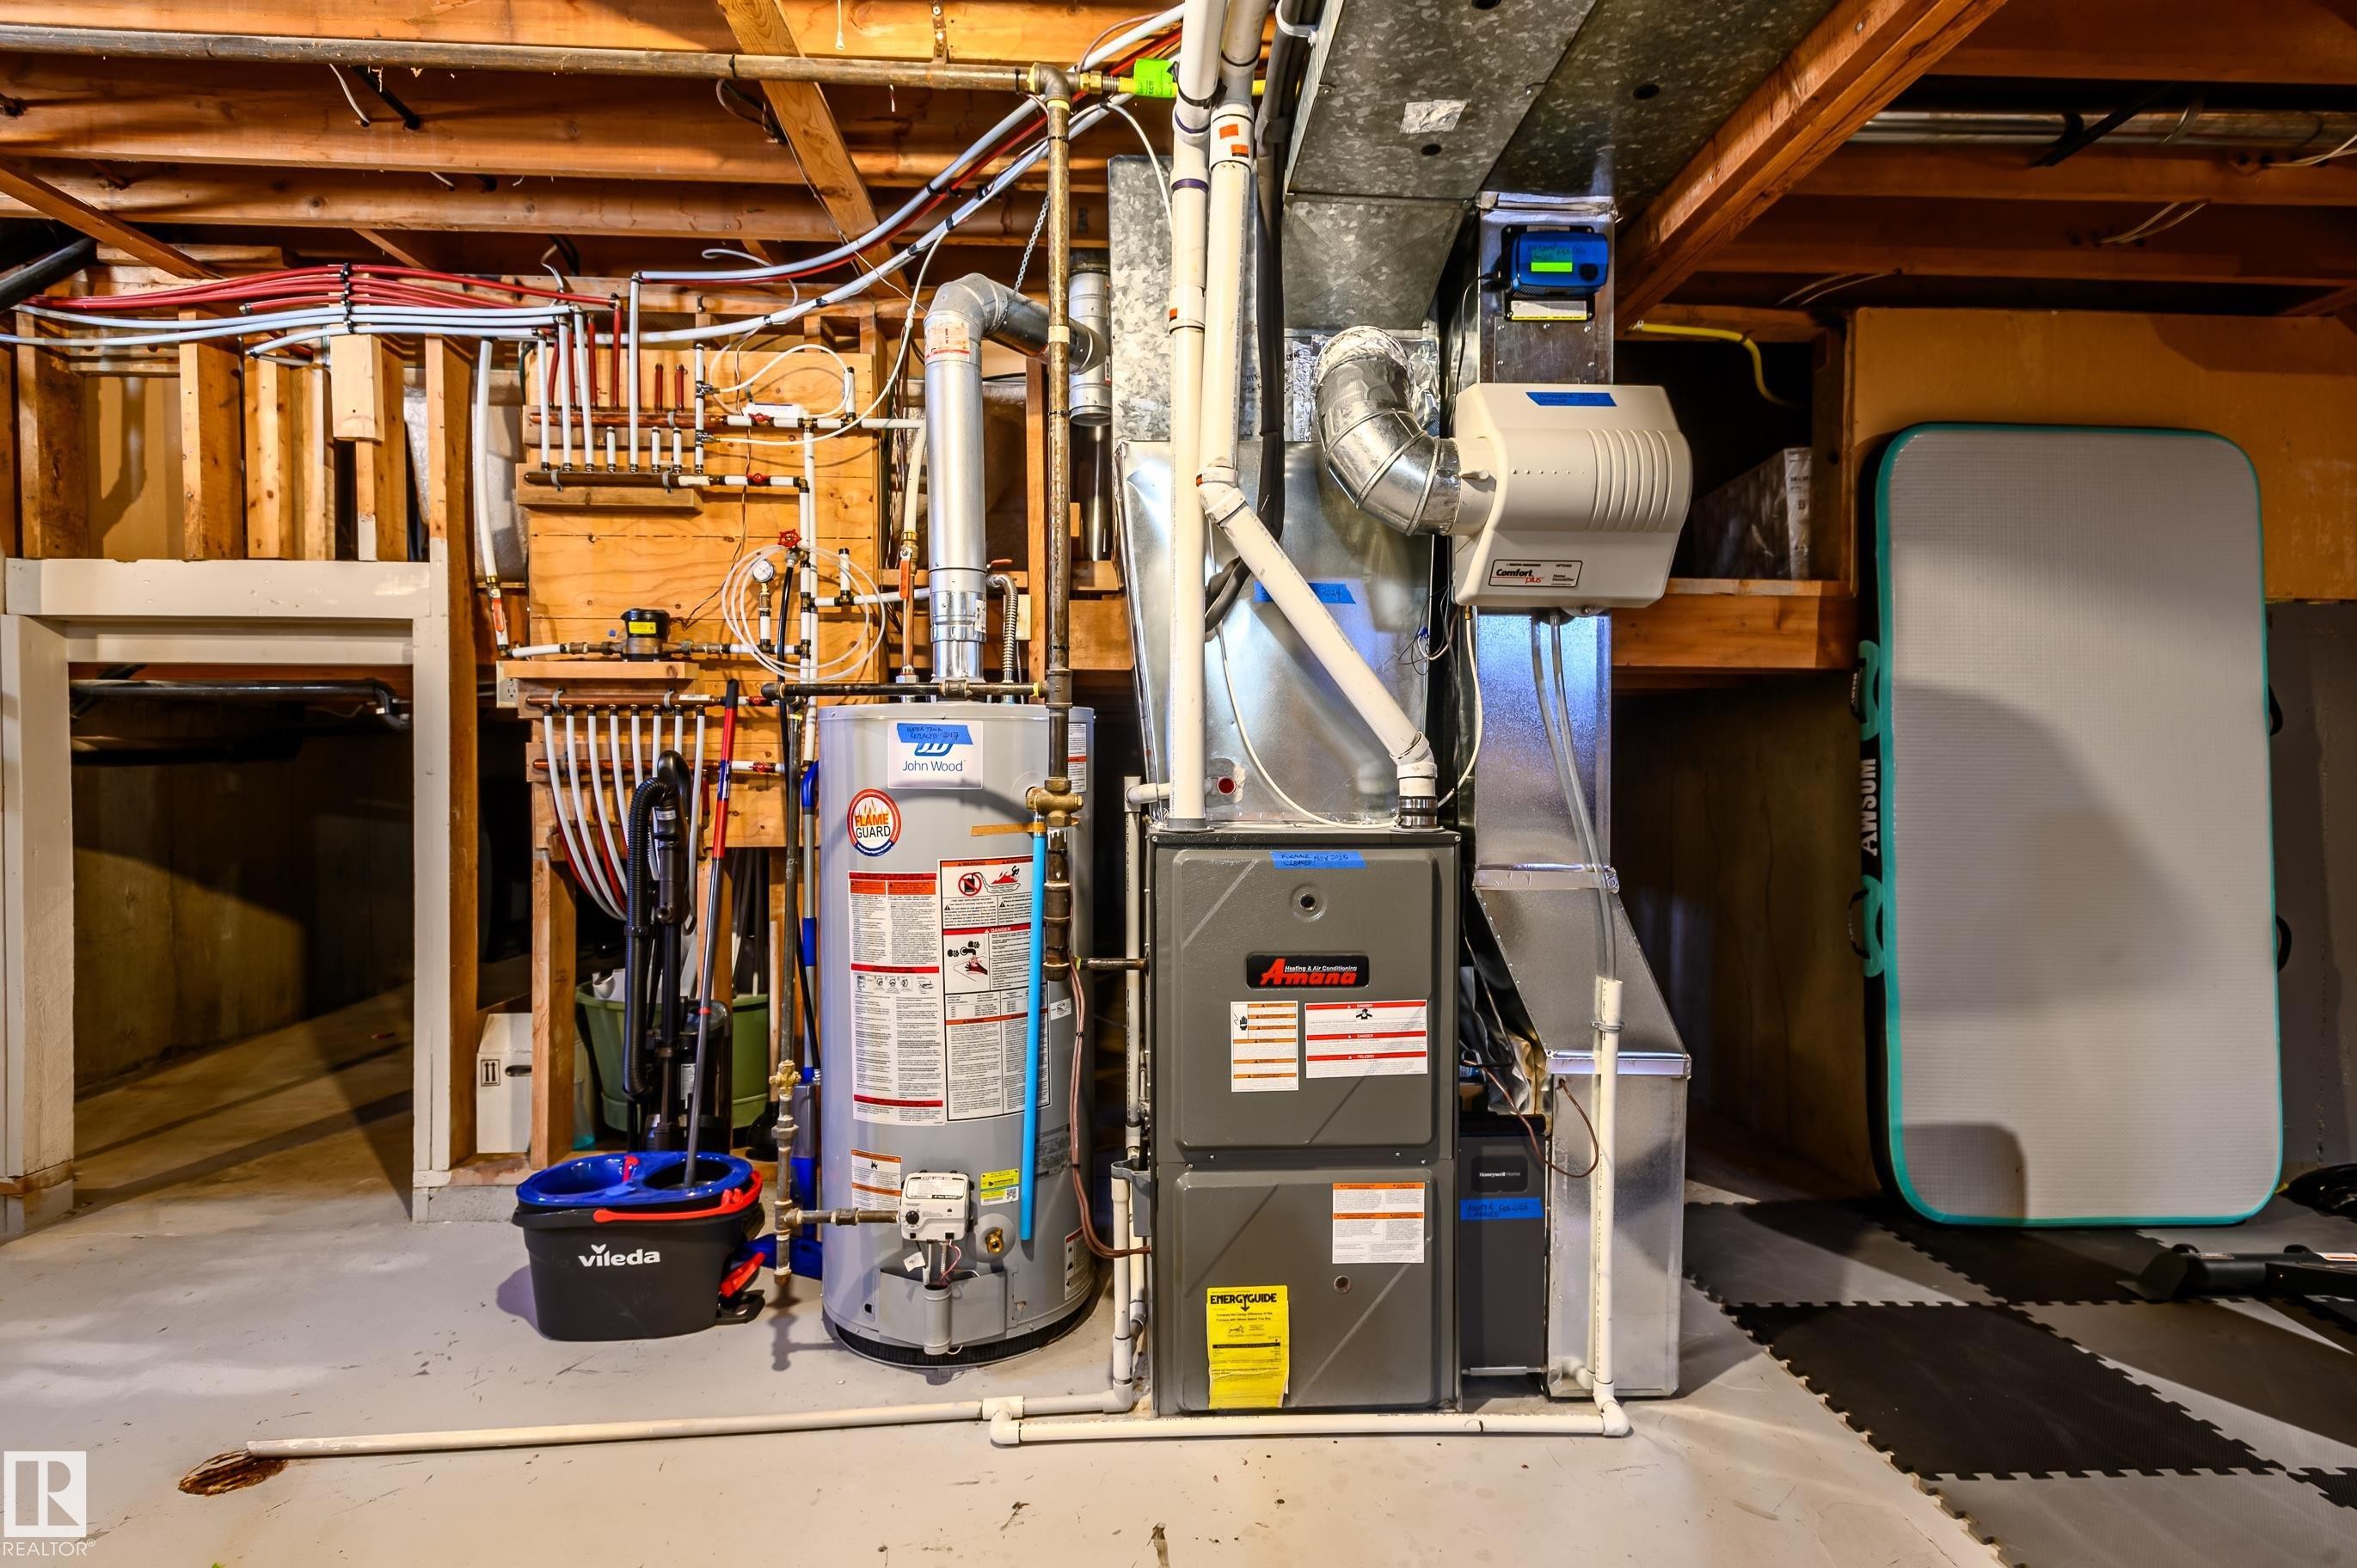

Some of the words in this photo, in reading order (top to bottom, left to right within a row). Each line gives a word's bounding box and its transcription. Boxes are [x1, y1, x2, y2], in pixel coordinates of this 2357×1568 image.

[1496, 568, 1533, 577] Comfort
[1525, 575, 1542, 585] plus
[902, 760, 929, 771] John
[930, 760, 963, 772] Wood
[1860, 758, 1878, 857] AWSUM
[854, 813, 889, 827] FLAME
[856, 825, 891, 839] GUARD
[1260, 958, 1357, 985] Amana
[578, 1243, 661, 1267] vileda
[1210, 1293, 1277, 1305] ENERGYGUIDE
